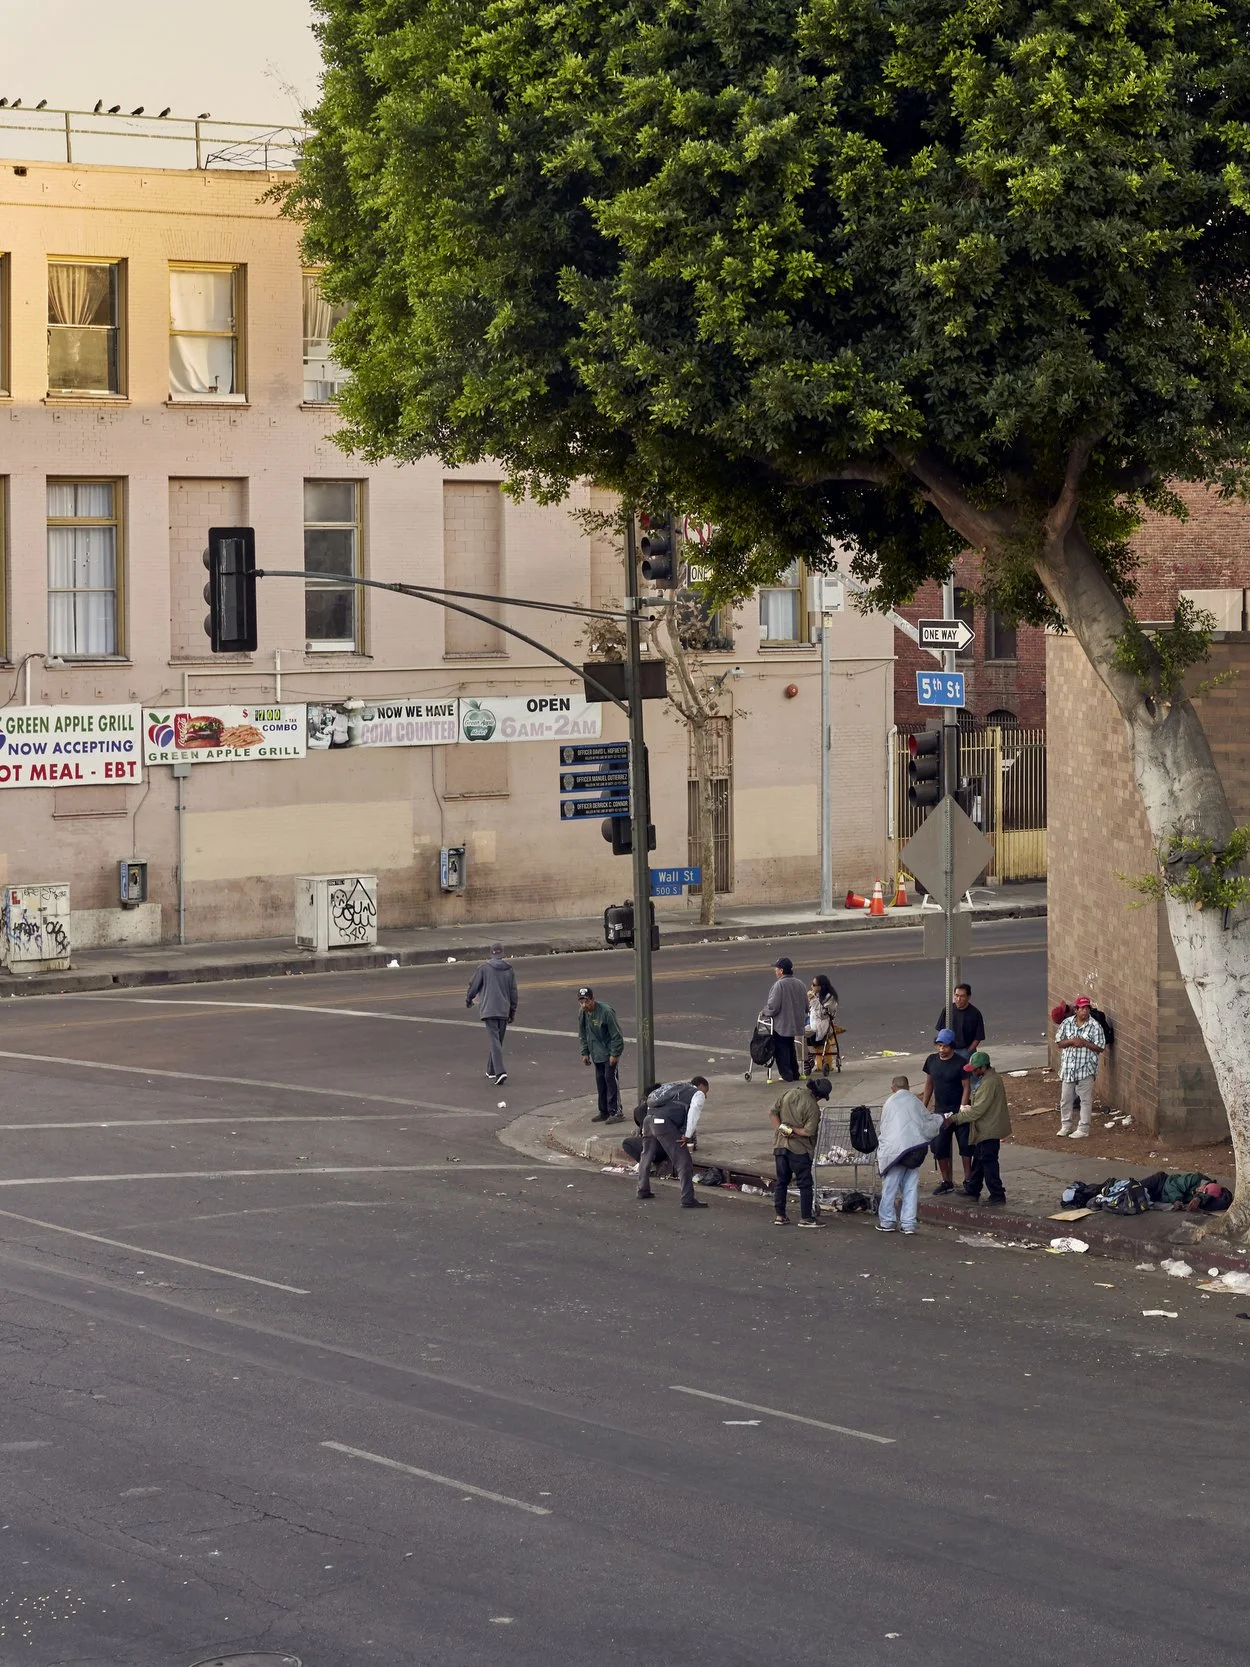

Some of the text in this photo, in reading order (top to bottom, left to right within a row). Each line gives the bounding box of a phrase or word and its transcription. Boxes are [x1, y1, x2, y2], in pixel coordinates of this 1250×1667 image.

[924, 629, 957, 640] ONE WAY
[922, 677, 960, 699] 5th St
[377, 706, 402, 719] NOW
[405, 705, 423, 718] WE
[425, 704, 454, 717] HAVE
[526, 698, 571, 712] OPEN
[6, 714, 134, 734] GREEN APPLE GRILL
[262, 723, 298, 732] COMBO
[360, 720, 456, 744] COIN COUNTER
[8, 740, 134, 755] NOW ACCEPTING
[148, 746, 300, 761] GREEN APPLE GRILL
[30, 763, 83, 781] MEAL
[104, 761, 137, 778] EBT
[658, 870, 694, 883] Wall St
[656, 886, 678, 895] 500 S
